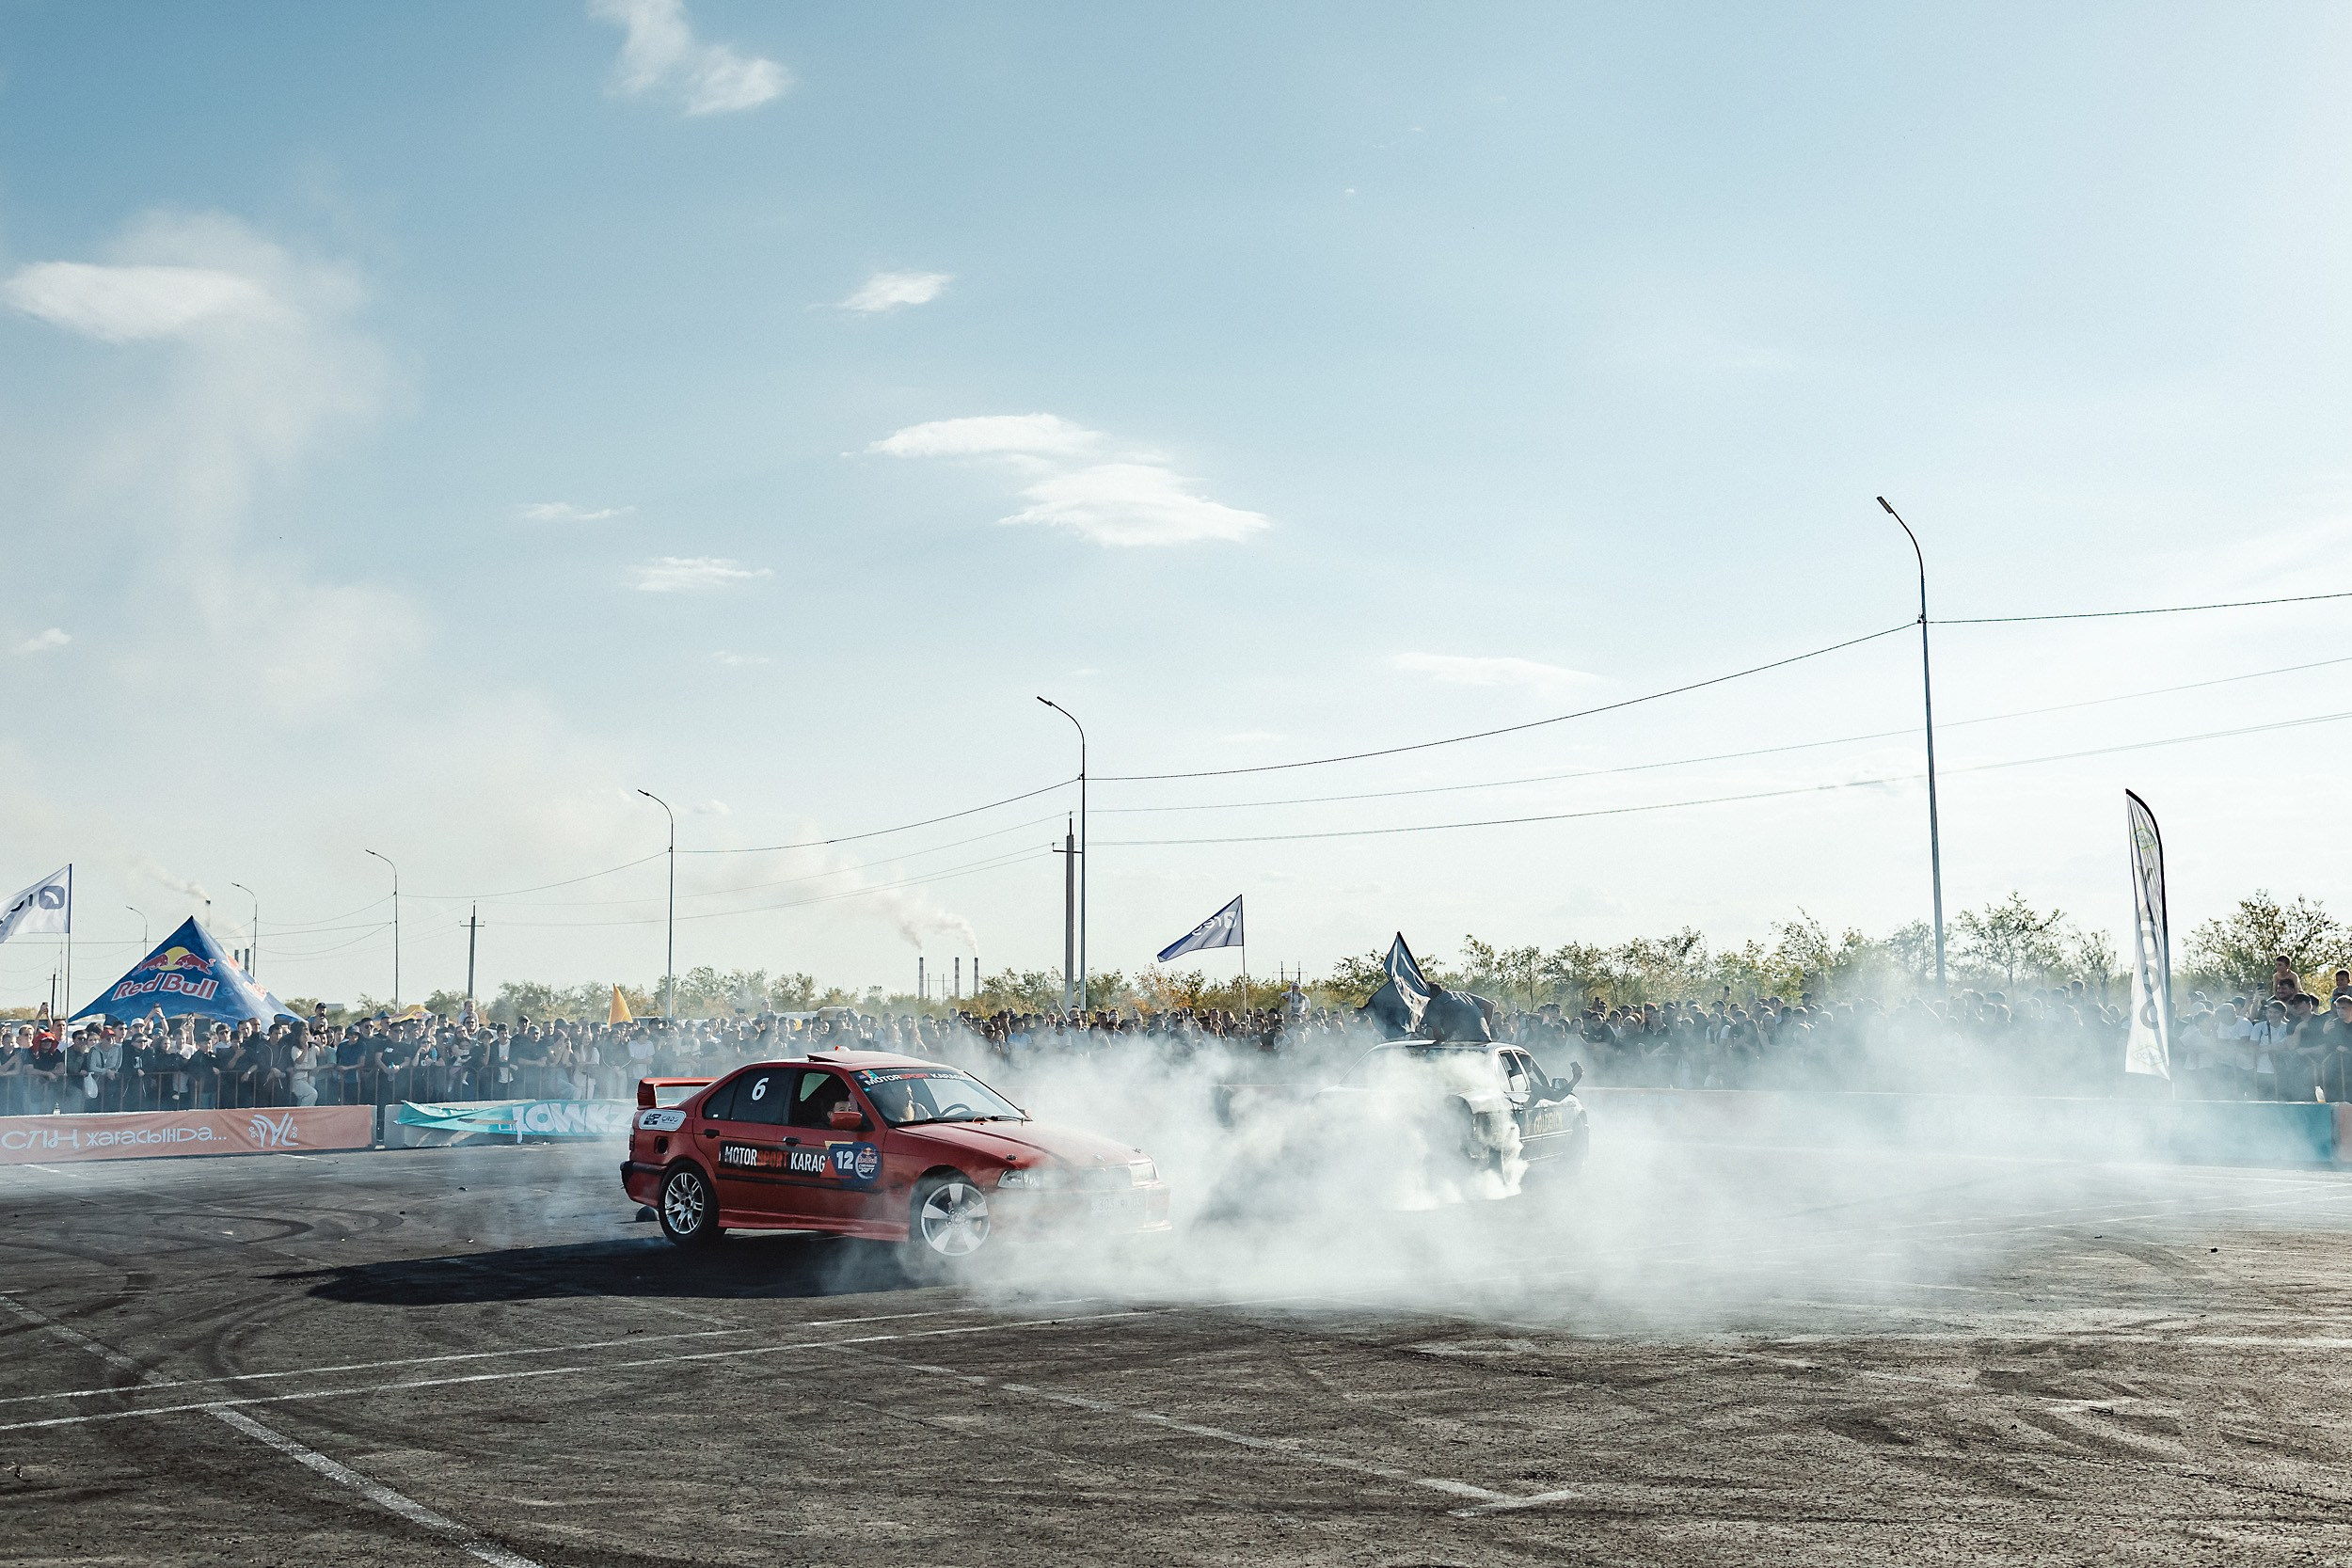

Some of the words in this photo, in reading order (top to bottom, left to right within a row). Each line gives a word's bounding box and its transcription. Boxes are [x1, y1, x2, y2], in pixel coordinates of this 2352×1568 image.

[112, 973, 161, 1001] Red
[160, 973, 219, 1000] Bull
[752, 1077, 770, 1101] 6
[790, 1152, 830, 1173] KARAG
[836, 1150, 854, 1170] 12
